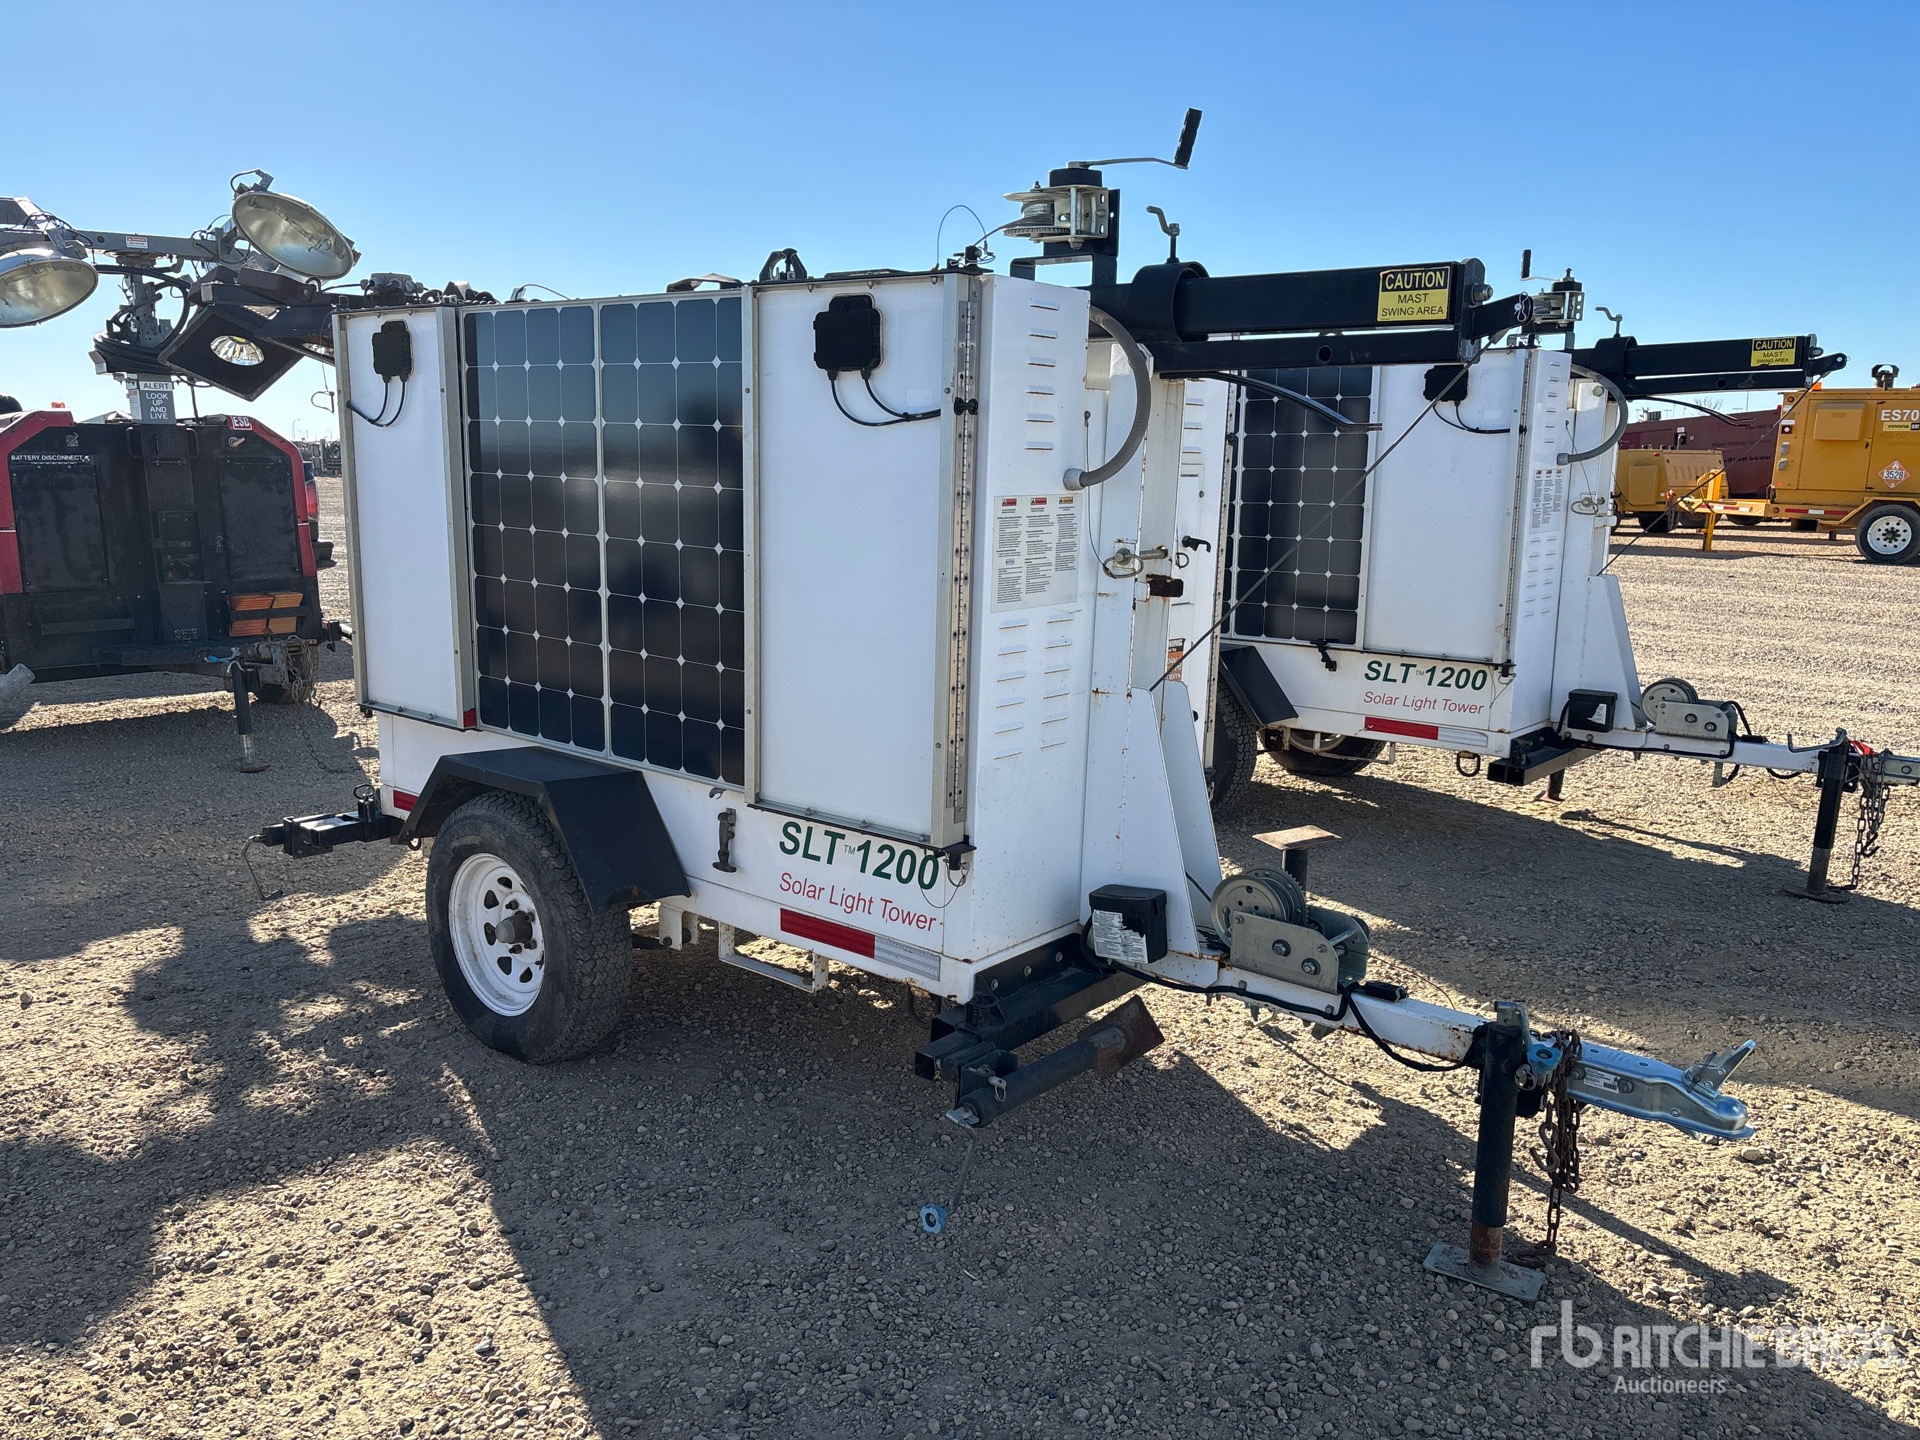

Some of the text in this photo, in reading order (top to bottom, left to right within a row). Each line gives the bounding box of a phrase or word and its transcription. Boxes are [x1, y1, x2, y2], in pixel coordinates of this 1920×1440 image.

[1385, 270, 1445, 290] CAUTION
[1397, 293, 1429, 304] MAST
[1381, 306, 1444, 317] SWING AREA
[1755, 339, 1793, 350] CAUTION
[143, 382, 169, 390] ALERT
[146, 392, 169, 400] LOOK
[1880, 409, 1919, 421] ES70
[1364, 660, 1417, 684] SLT
[1425, 665, 1488, 691] 1200
[1363, 691, 1485, 715] Solar Light Tower
[779, 821, 846, 866] SLT
[857, 839, 940, 890] 1200
[779, 872, 937, 932] Solar Light Tower
